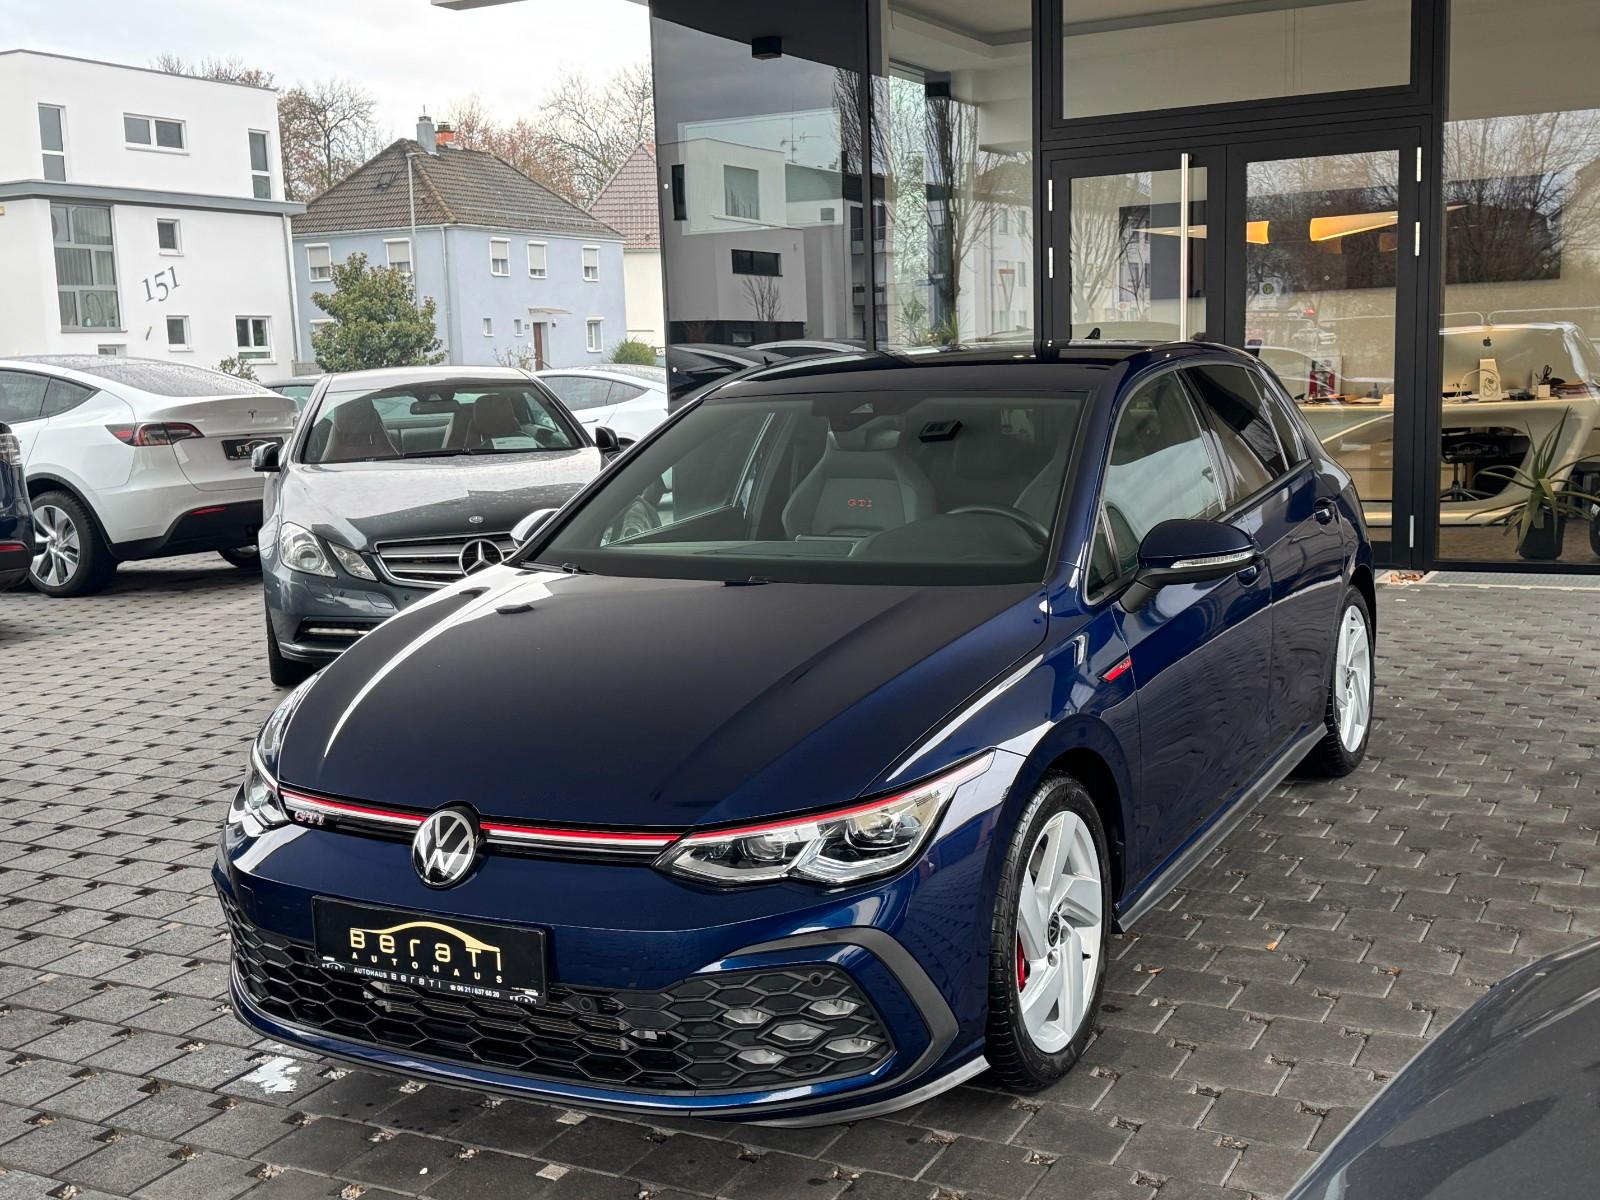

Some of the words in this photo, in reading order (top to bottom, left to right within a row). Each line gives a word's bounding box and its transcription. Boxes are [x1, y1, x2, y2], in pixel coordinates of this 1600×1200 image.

[142, 266, 181, 302] 151
[847, 498, 873, 508] GTI
[294, 810, 325, 826] GTI
[352, 951, 503, 984] AUTOHAUS
[353, 967, 388, 979] AUTOHAUS
